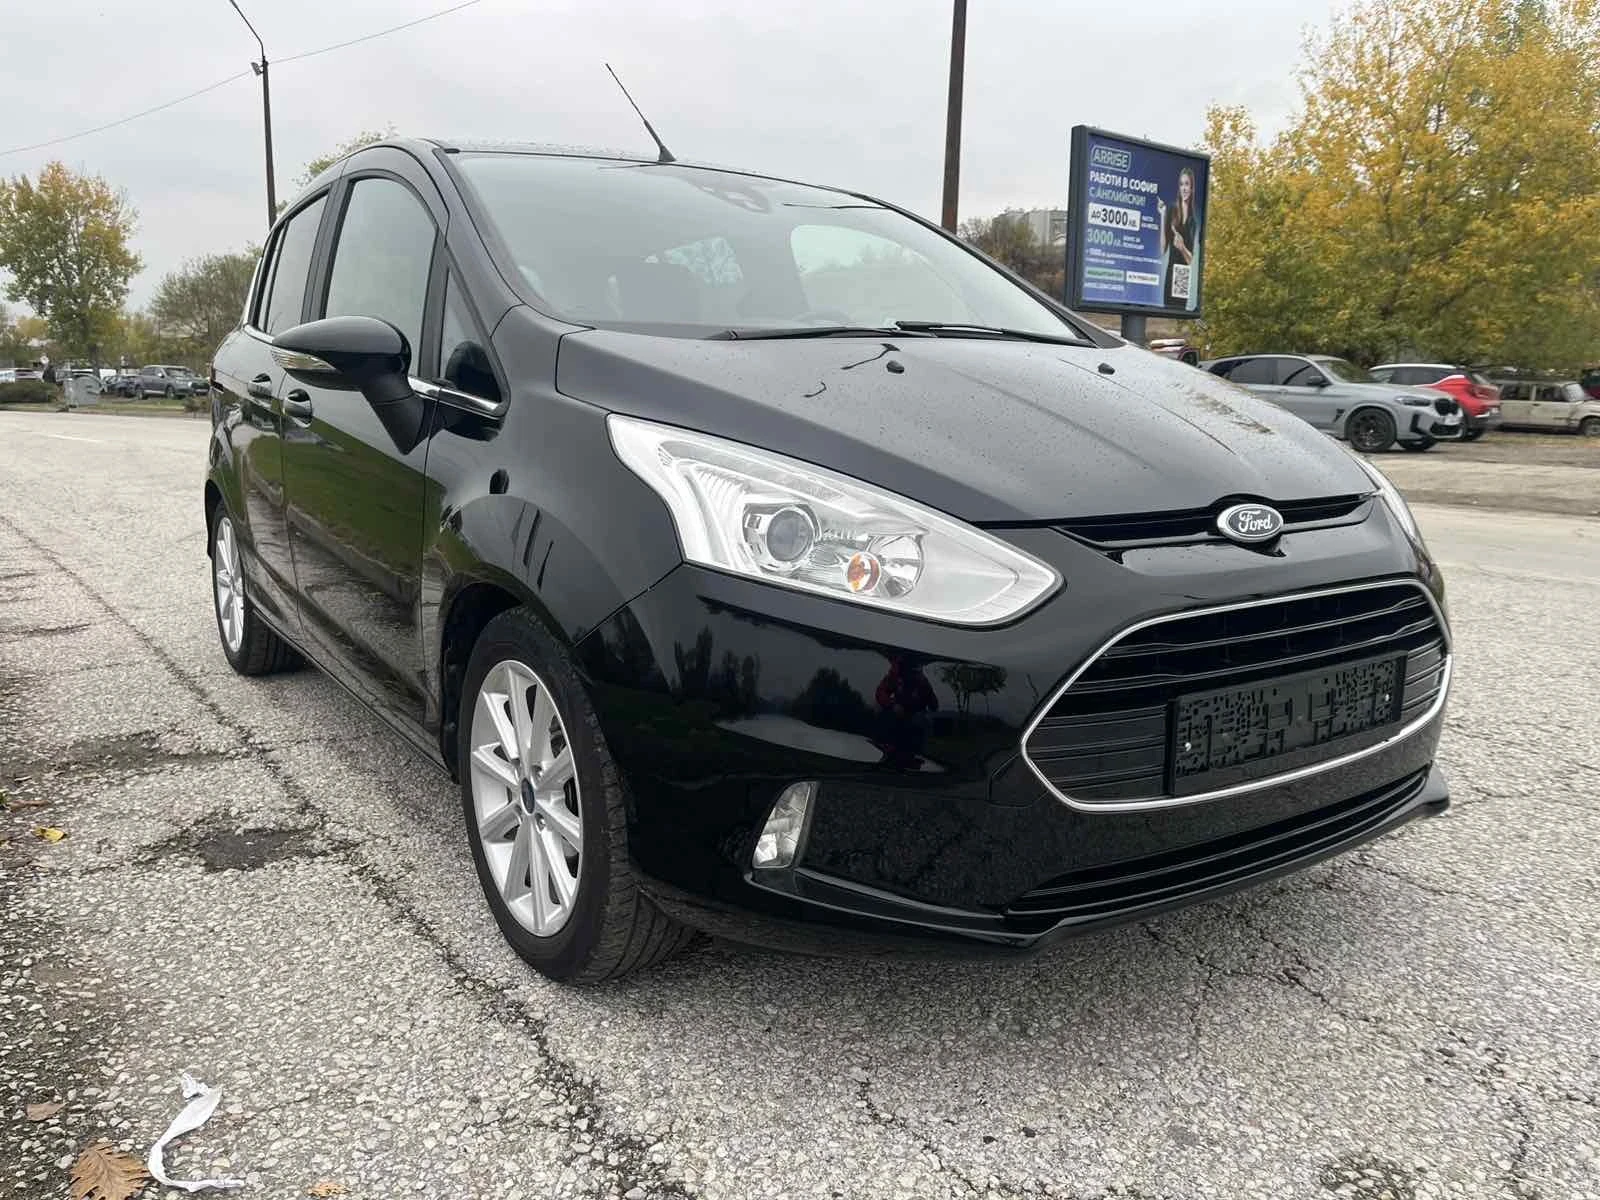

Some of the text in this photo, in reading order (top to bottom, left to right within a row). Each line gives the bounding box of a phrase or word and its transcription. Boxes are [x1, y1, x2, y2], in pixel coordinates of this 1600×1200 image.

[1090, 170, 1121, 187] РАБОТИ
[1129, 179, 1158, 194] СОФИЯ
[1101, 208, 1128, 226] 3000
[1087, 228, 1114, 246] 3000
[1239, 510, 1272, 532] Ford
